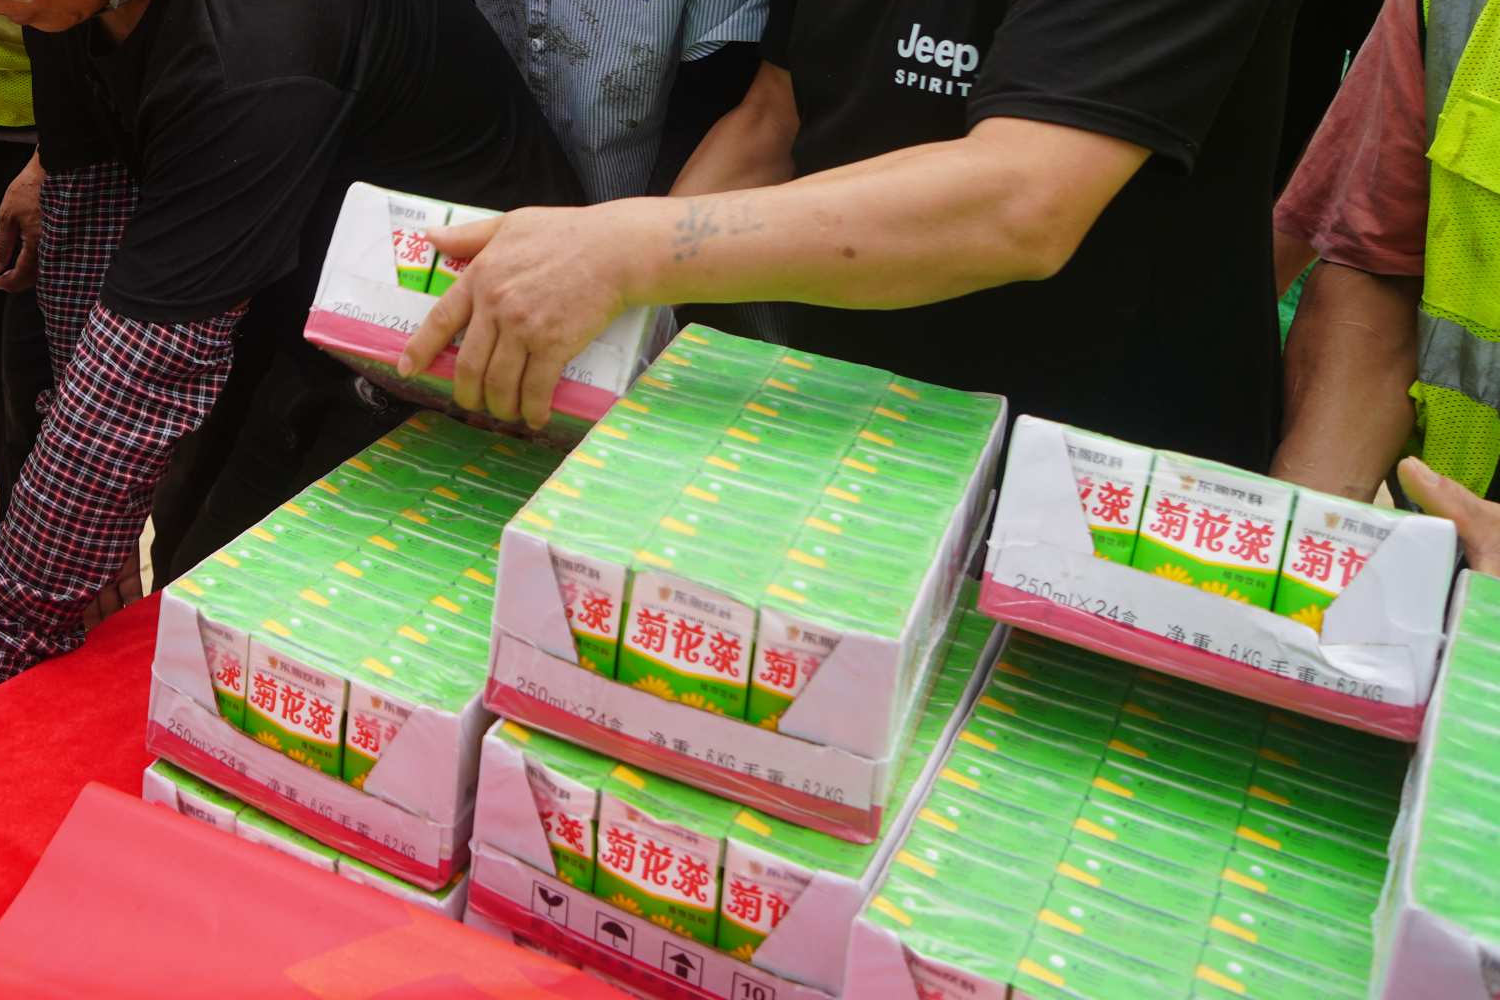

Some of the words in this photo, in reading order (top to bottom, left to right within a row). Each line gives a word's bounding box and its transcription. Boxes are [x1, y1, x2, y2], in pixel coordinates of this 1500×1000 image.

[894, 68, 973, 97] SPIRIT
[897, 23, 979, 77] Jeep
[1149, 497, 1275, 565] 菊花茶
[631, 608, 742, 678] 菊花茶
[251, 671, 335, 739] 菊花茶
[602, 827, 709, 903] 菊花茶
